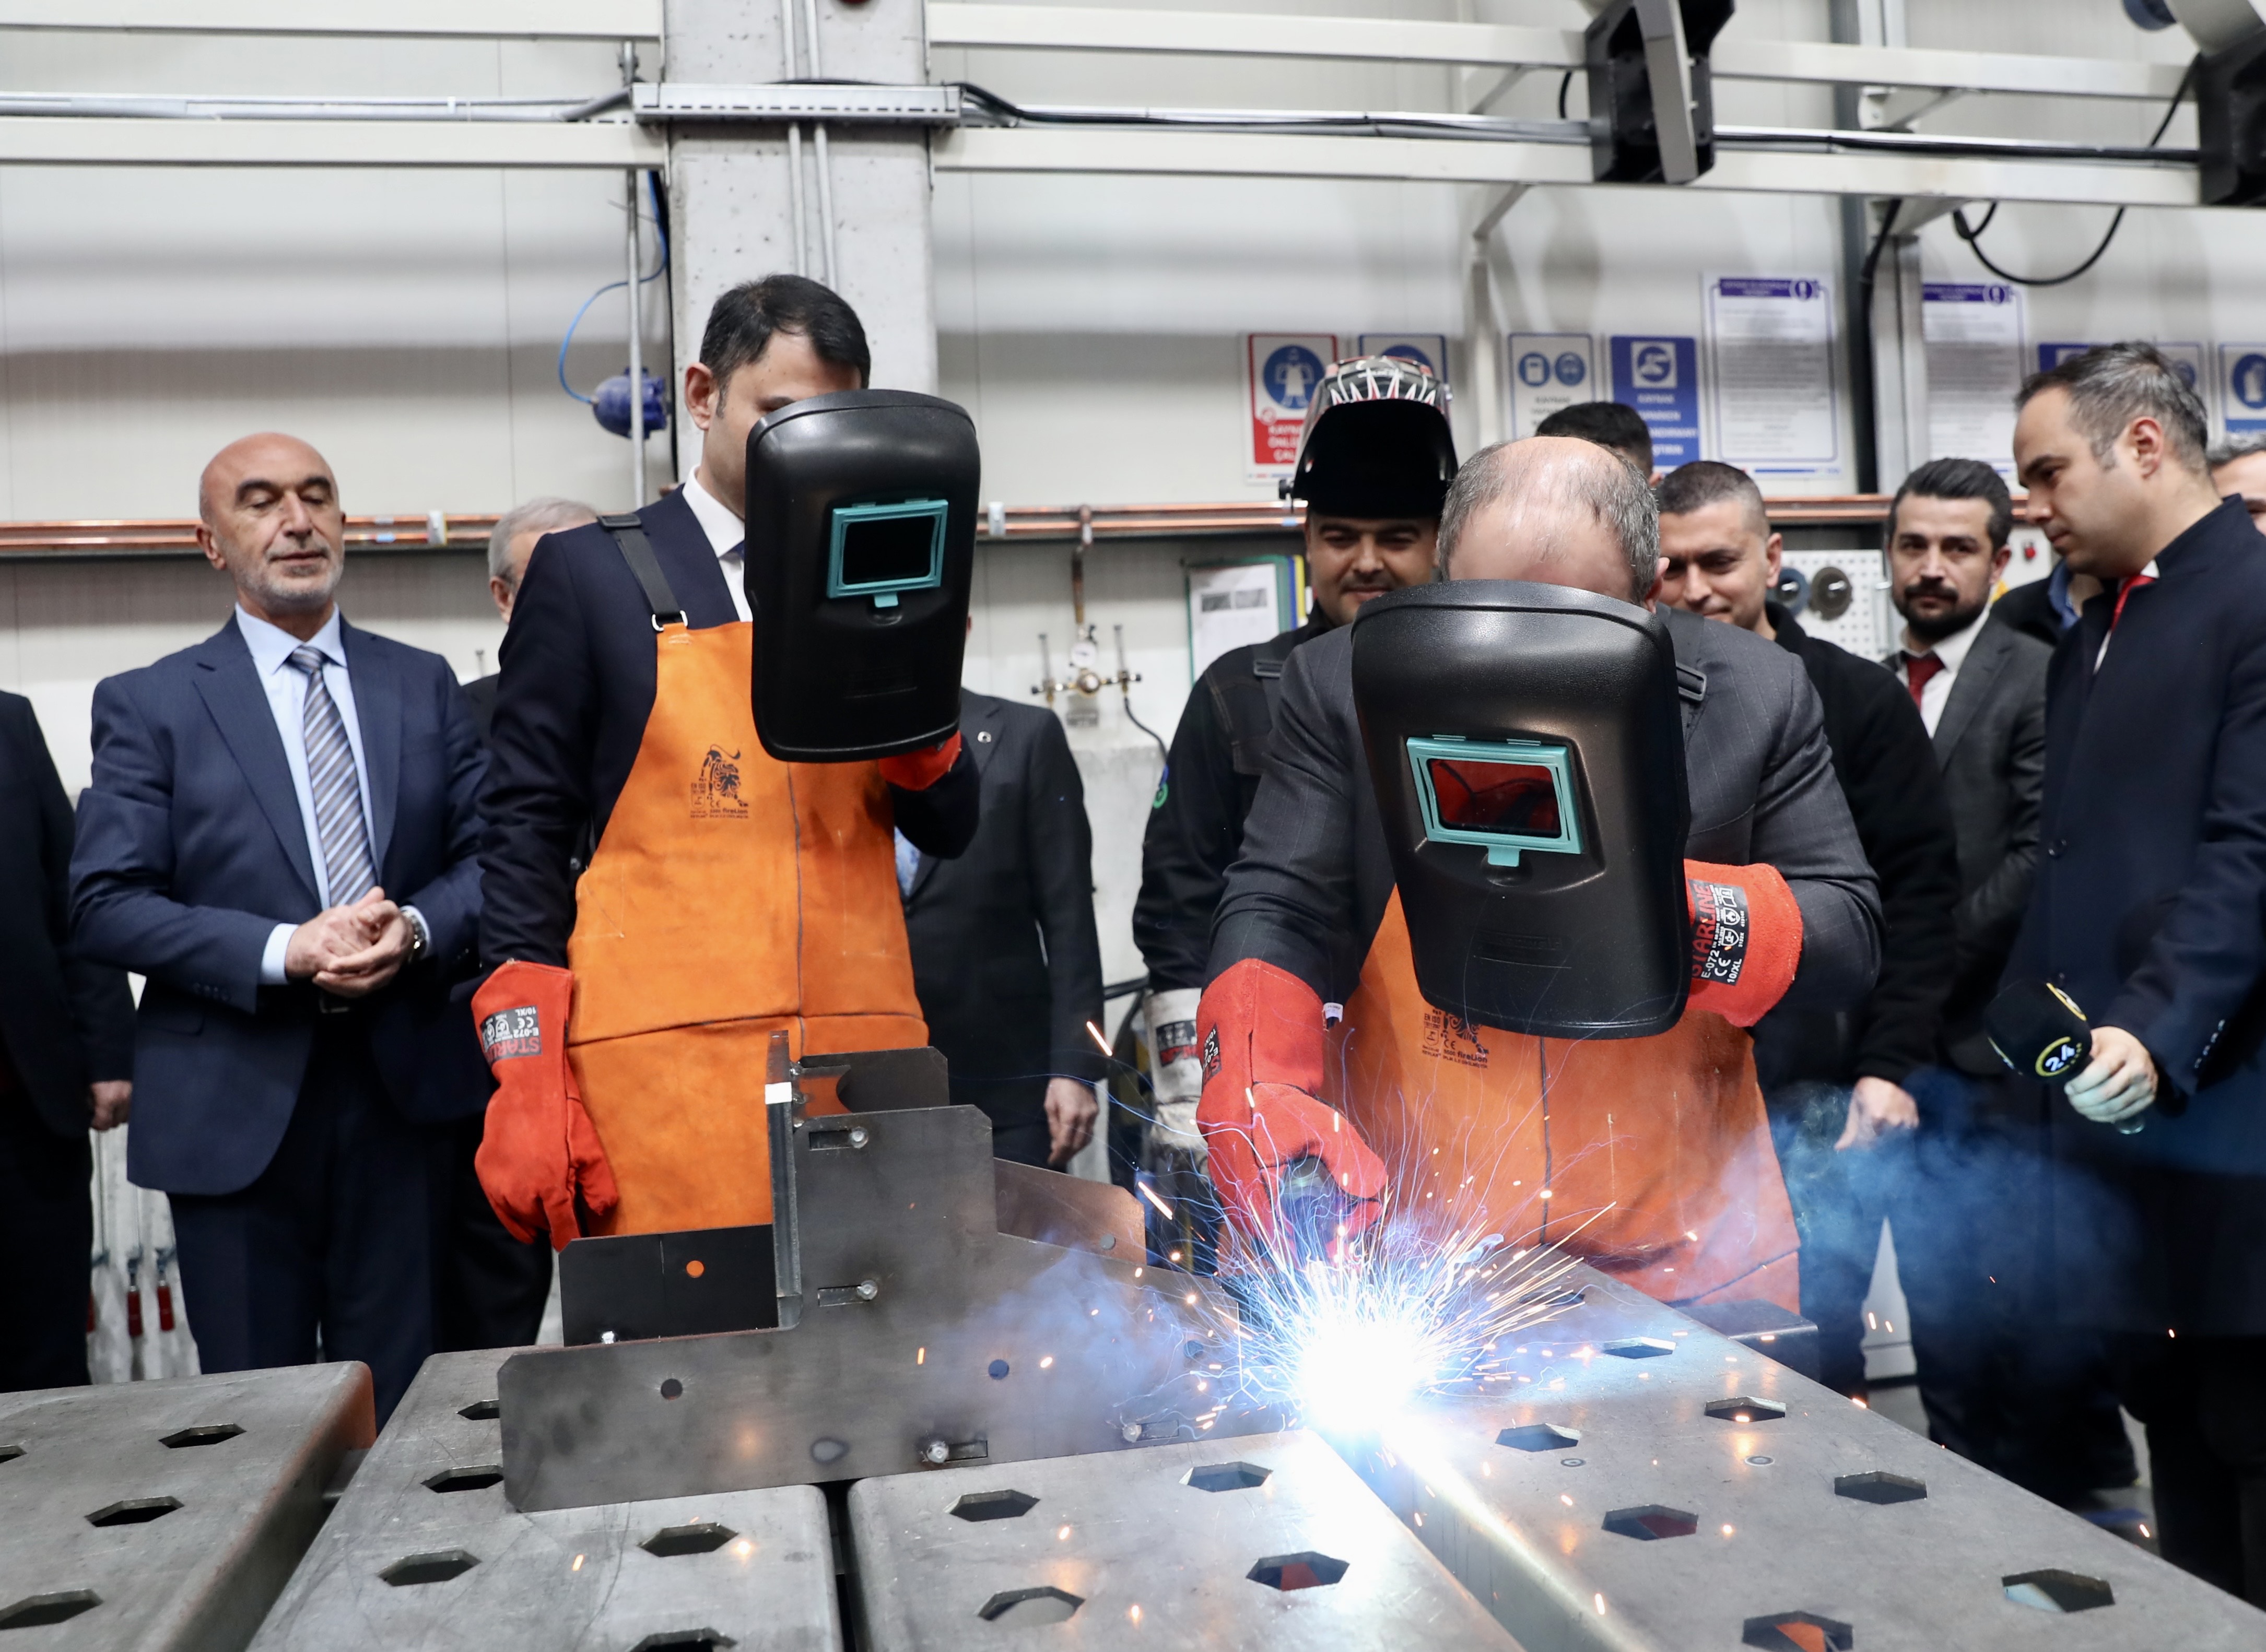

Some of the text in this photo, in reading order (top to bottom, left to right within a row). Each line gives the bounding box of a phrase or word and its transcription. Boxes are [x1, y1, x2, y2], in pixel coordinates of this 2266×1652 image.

[1701, 949, 1720, 978] E-072
[1727, 959, 1743, 983] 10/XL
[513, 1027, 539, 1038] E-072
[2045, 1044, 2076, 1072] 24
